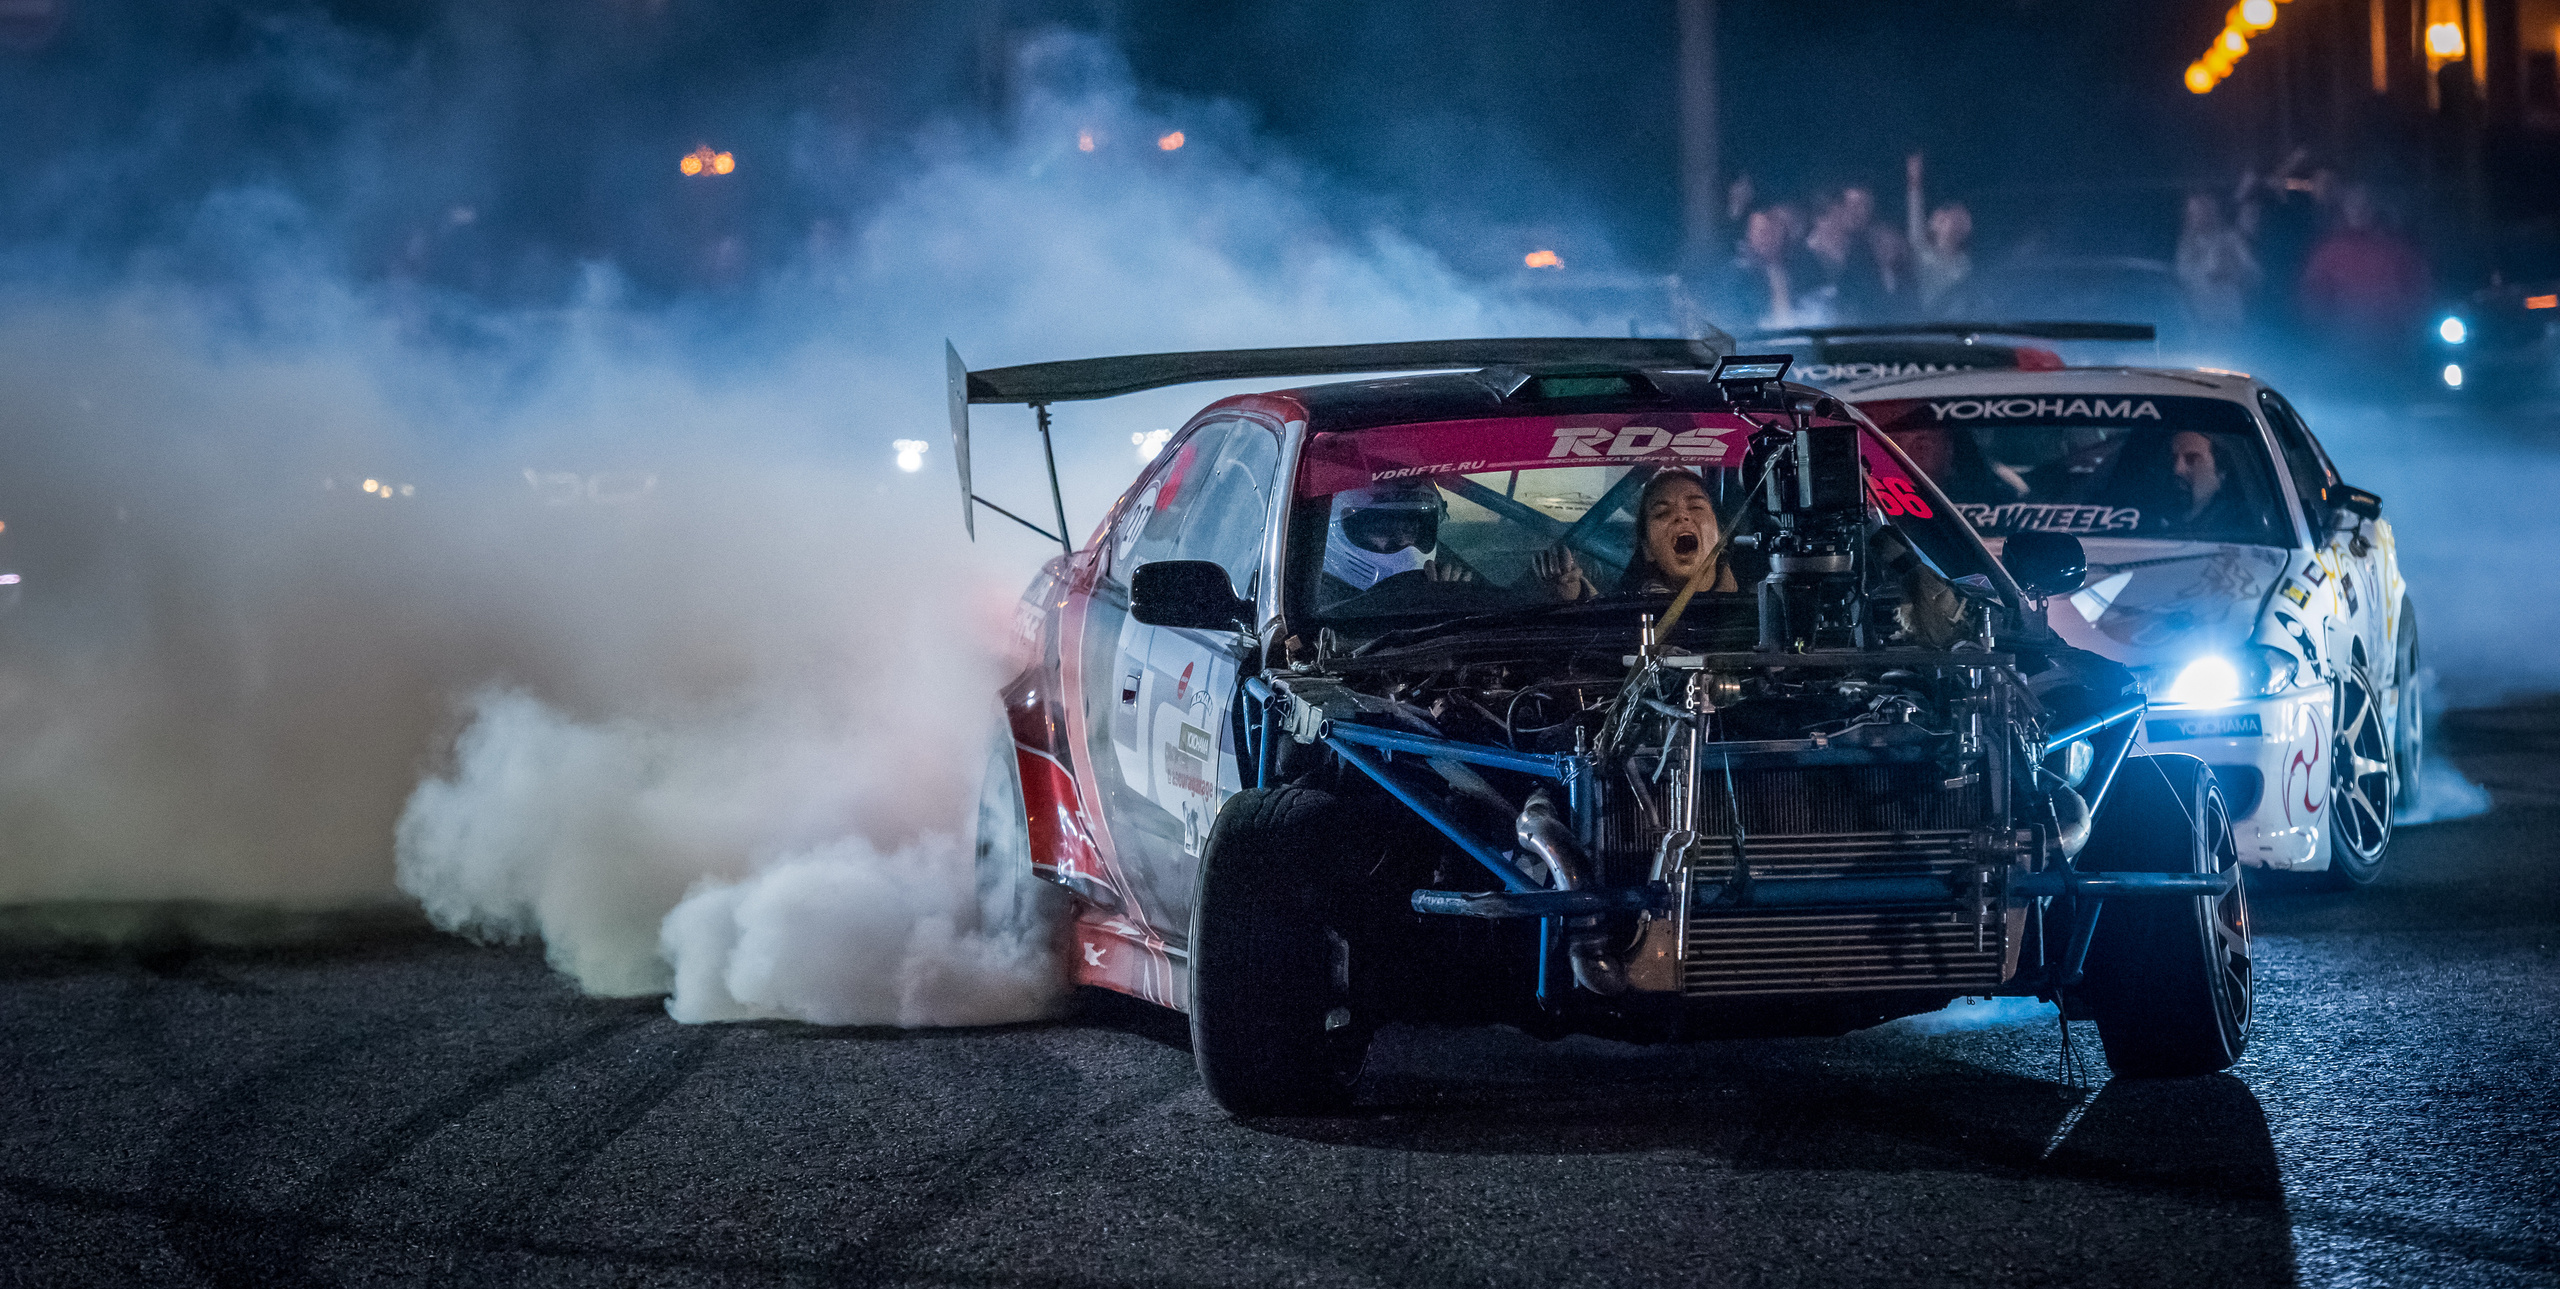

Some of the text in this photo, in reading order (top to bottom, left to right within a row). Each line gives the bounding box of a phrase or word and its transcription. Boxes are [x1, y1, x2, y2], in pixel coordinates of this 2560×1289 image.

[1793, 362, 1974, 380] YOKOHA
[1930, 399, 2162, 420] YOKOHAMA
[1547, 427, 1738, 457] RDS
[1371, 460, 1487, 481] VDRIFTE.RU
[2178, 718, 2259, 735] YOKOHAMA
